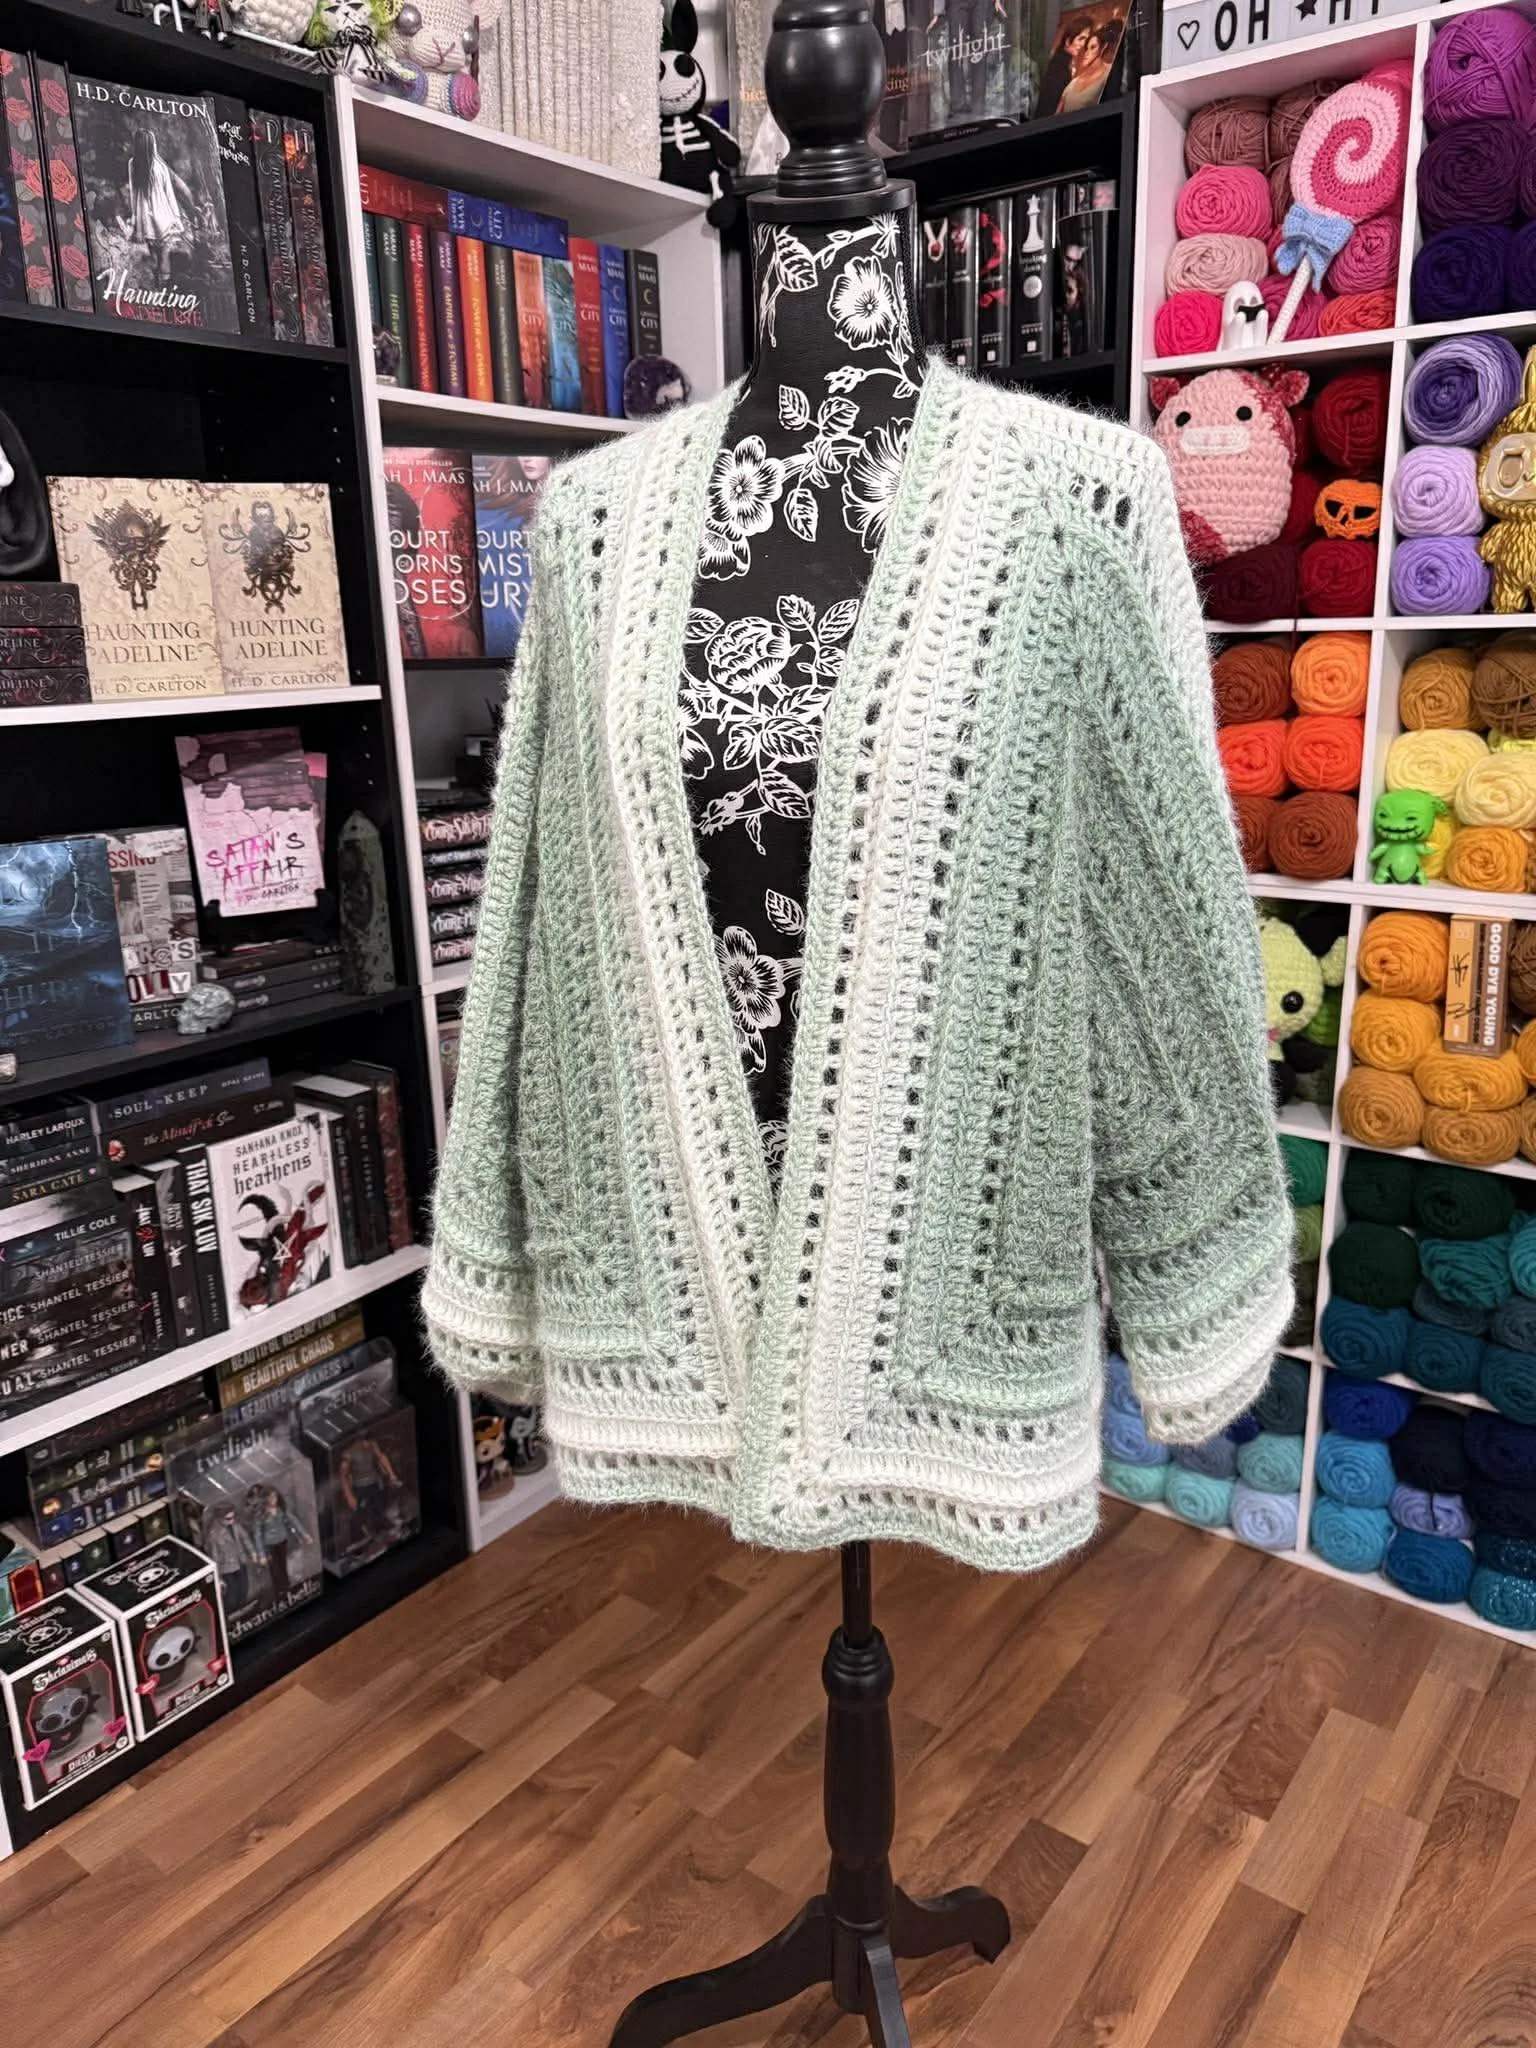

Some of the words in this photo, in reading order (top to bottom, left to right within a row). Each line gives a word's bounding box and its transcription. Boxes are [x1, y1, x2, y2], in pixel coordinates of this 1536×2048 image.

[1215, 0, 1270, 50] OH
[918, 21, 1011, 67] twilight
[76, 82, 114, 103] H.D.
[119, 91, 207, 118] CARLTON
[493, 208, 503, 240] CITY
[96, 268, 199, 316] Haunting
[243, 272, 256, 323] CARLTON
[414, 273, 424, 315] QUEEN
[444, 285, 454, 327] EMPIRE
[472, 297, 482, 335] TOWER
[522, 313, 542, 325] CITY
[640, 317, 657, 329] CITY
[448, 342, 458, 388] STORMS
[475, 352, 487, 387] DAWN
[408, 469, 418, 485] J.
[423, 469, 465, 484] MAAS
[496, 480, 506, 494] J.
[390, 530, 450, 552] OURT
[476, 530, 534, 550] OURT
[395, 554, 464, 575] ORNS
[394, 578, 467, 605] OSES
[88, 621, 200, 641] HAUNTING
[231, 617, 325, 637] HUNTING
[99, 644, 199, 664] ADELINE
[235, 639, 329, 660] ADELINE
[136, 678, 207, 693] CARLTON
[271, 672, 337, 686] CARLTON
[206, 831, 305, 868] SATAN'S
[222, 856, 306, 890] AFFAIR
[1488, 922, 1502, 964] GOOD
[127, 969, 191, 1003] OLLY
[1487, 966, 1500, 995] DYE
[133, 1004, 181, 1023] ARLTO
[1484, 996, 1498, 1046] YOUNG
[114, 1100, 153, 1119] SOUL
[164, 1085, 208, 1105] KEEP
[6, 1127, 44, 1145] HARLEY
[46, 1117, 86, 1135] LAROUX
[10, 1155, 62, 1174] SHERIDAN
[65, 1146, 91, 1159] ANNE
[234, 1155, 312, 1195] heathens
[12, 1184, 47, 1202] SARA
[185, 1158, 210, 1197] THAT
[55, 1224, 86, 1241] TILLIE
[89, 1214, 118, 1231] COLE
[191, 1197, 215, 1226] SIK
[194, 1223, 218, 1253] LUV
[36, 1258, 82, 1280] SHANTEL
[80, 1243, 124, 1263] TESSIER
[30, 1288, 82, 1313] SHANTEL
[85, 1271, 130, 1292] TESSIER
[38, 1319, 89, 1344] SHANTEL
[91, 1301, 136, 1323] TESSIER
[40, 1353, 91, 1379] SHANTEL
[94, 1335, 137, 1358] TESSIER
[243, 1353, 300, 1393] BEAUTIFUL
[302, 1333, 335, 1364] CHAOS
[229, 1598, 282, 1638] dward
